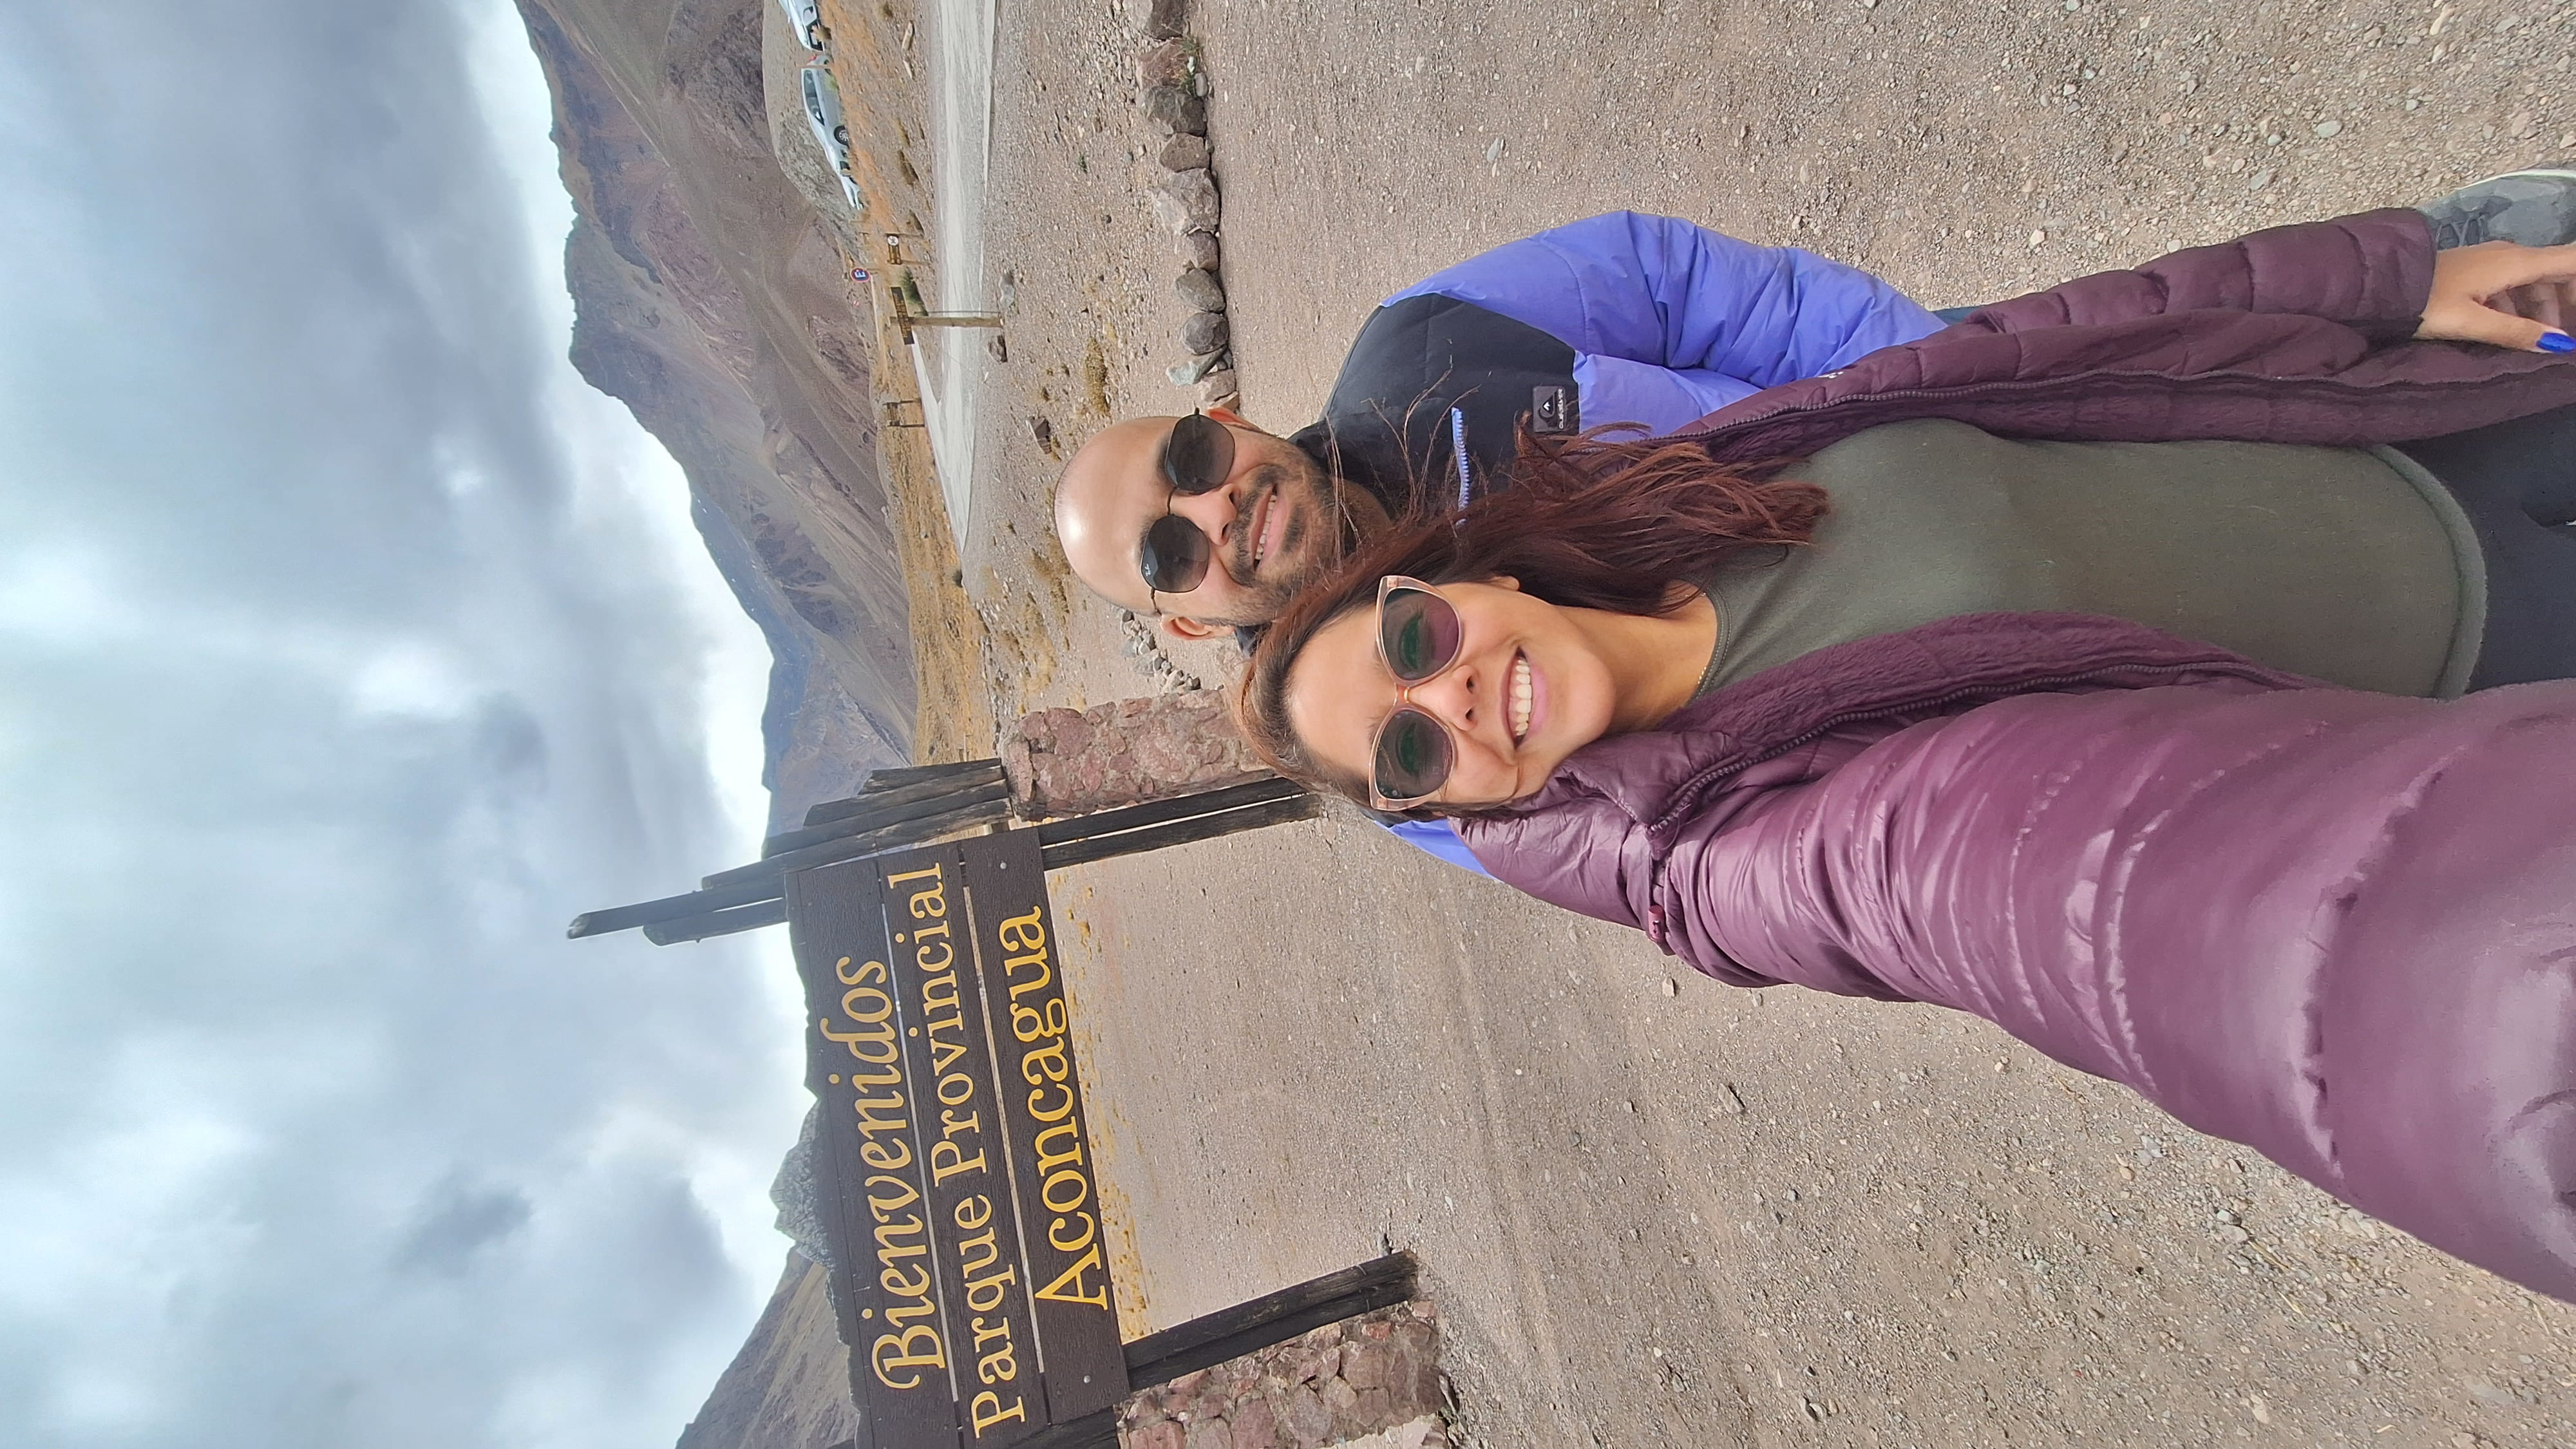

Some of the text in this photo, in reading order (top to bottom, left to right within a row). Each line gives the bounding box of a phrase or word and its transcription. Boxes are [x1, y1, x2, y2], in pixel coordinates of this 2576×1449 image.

[820, 957, 946, 1388] Bienvenidos
[888, 862, 1025, 1438] Parque Provincial
[999, 905, 1108, 1311] Aconcagua
